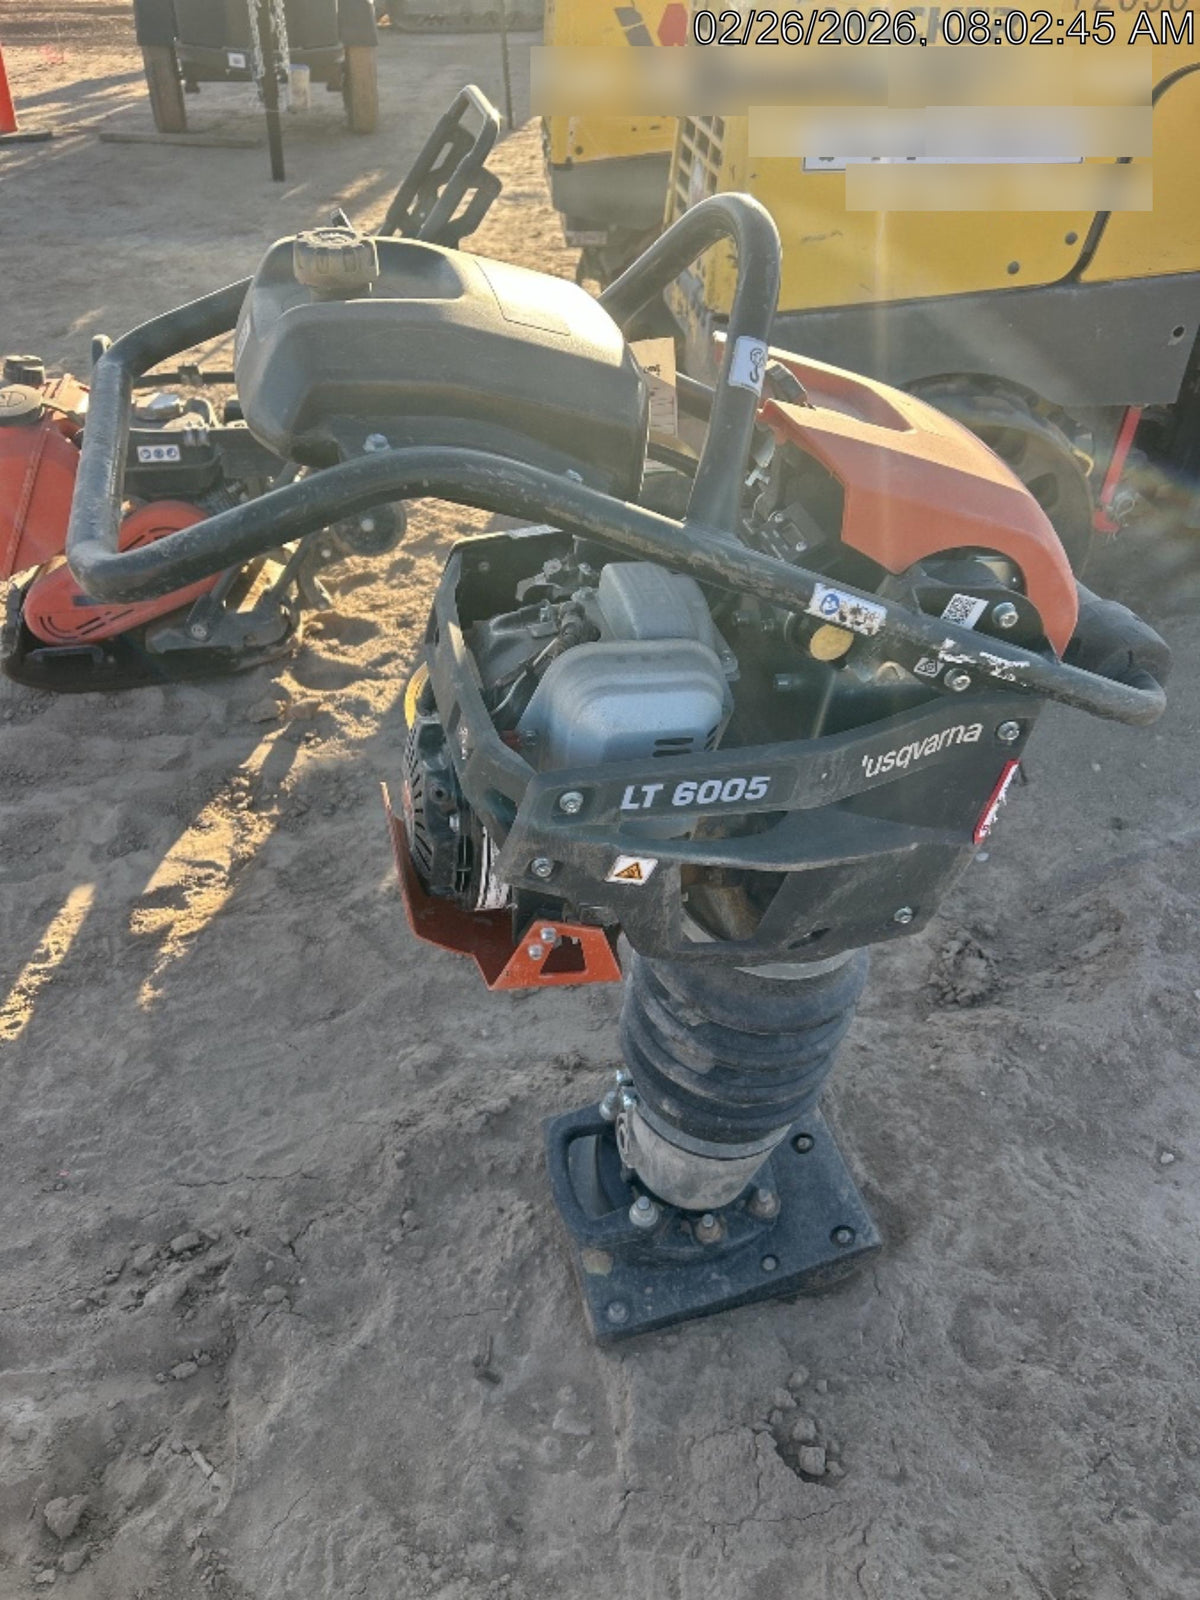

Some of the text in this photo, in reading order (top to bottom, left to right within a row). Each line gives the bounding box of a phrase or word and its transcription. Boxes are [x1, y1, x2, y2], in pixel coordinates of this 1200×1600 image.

[861, 722, 984, 778] usqvarna
[620, 776, 771, 810] LT 6005
